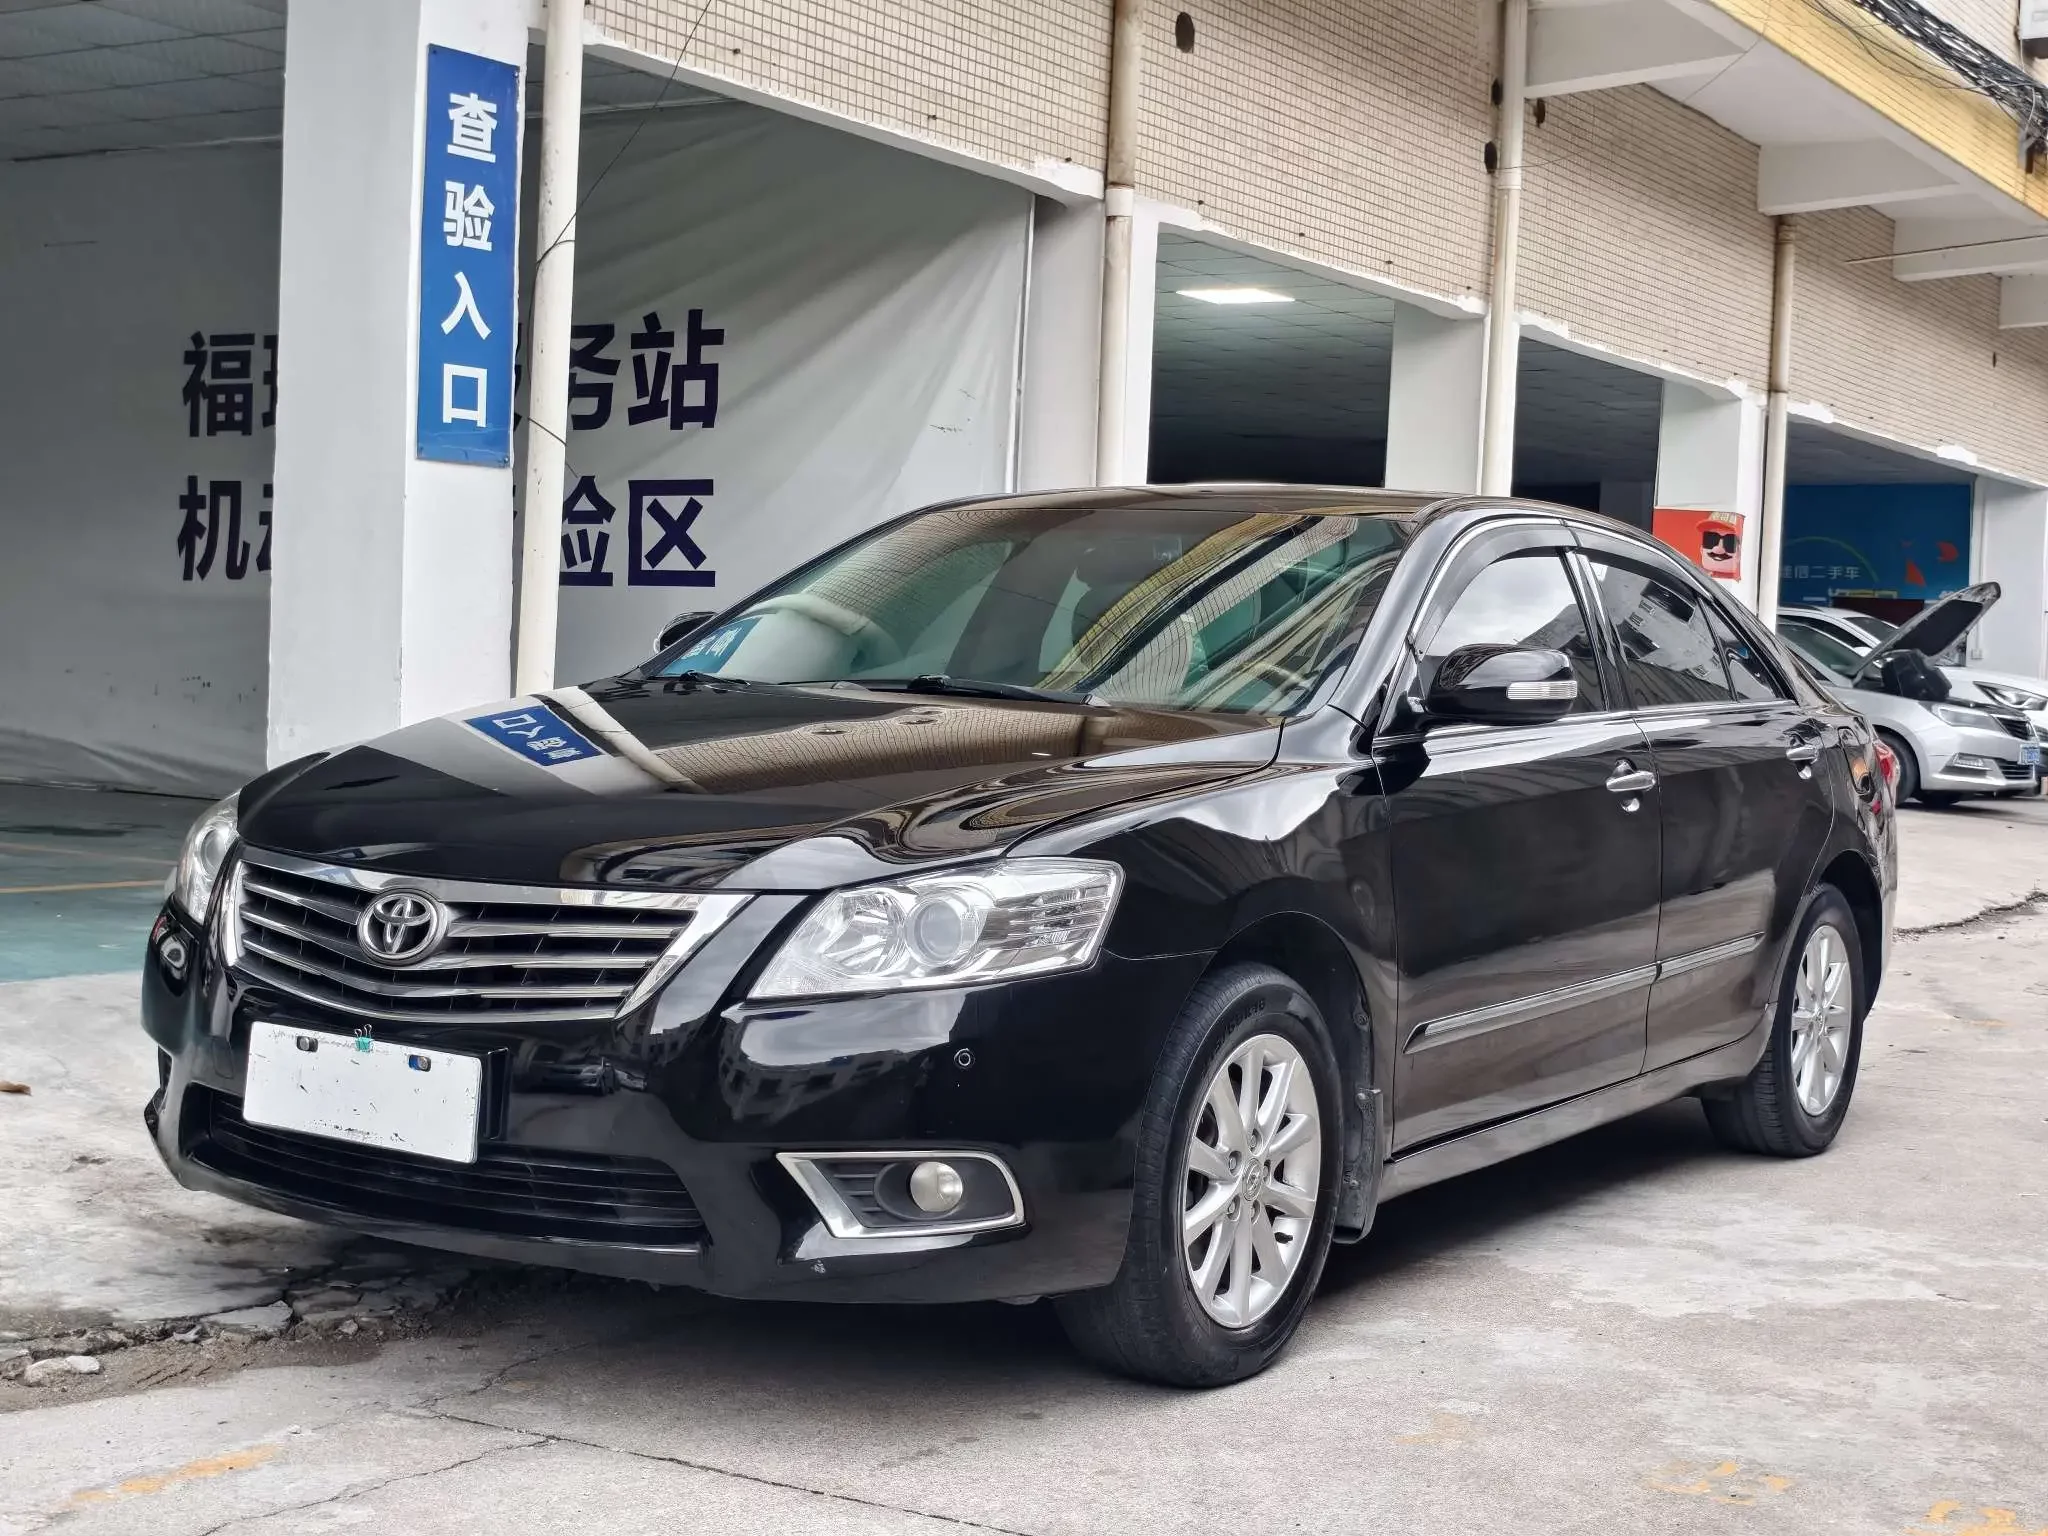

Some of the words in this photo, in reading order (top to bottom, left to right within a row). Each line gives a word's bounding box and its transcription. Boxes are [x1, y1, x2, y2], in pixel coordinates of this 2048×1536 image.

[441, 92, 498, 428] 查验入口
[182, 330, 278, 437] 福
[515, 308, 725, 432] 务站
[177, 475, 273, 581] 机
